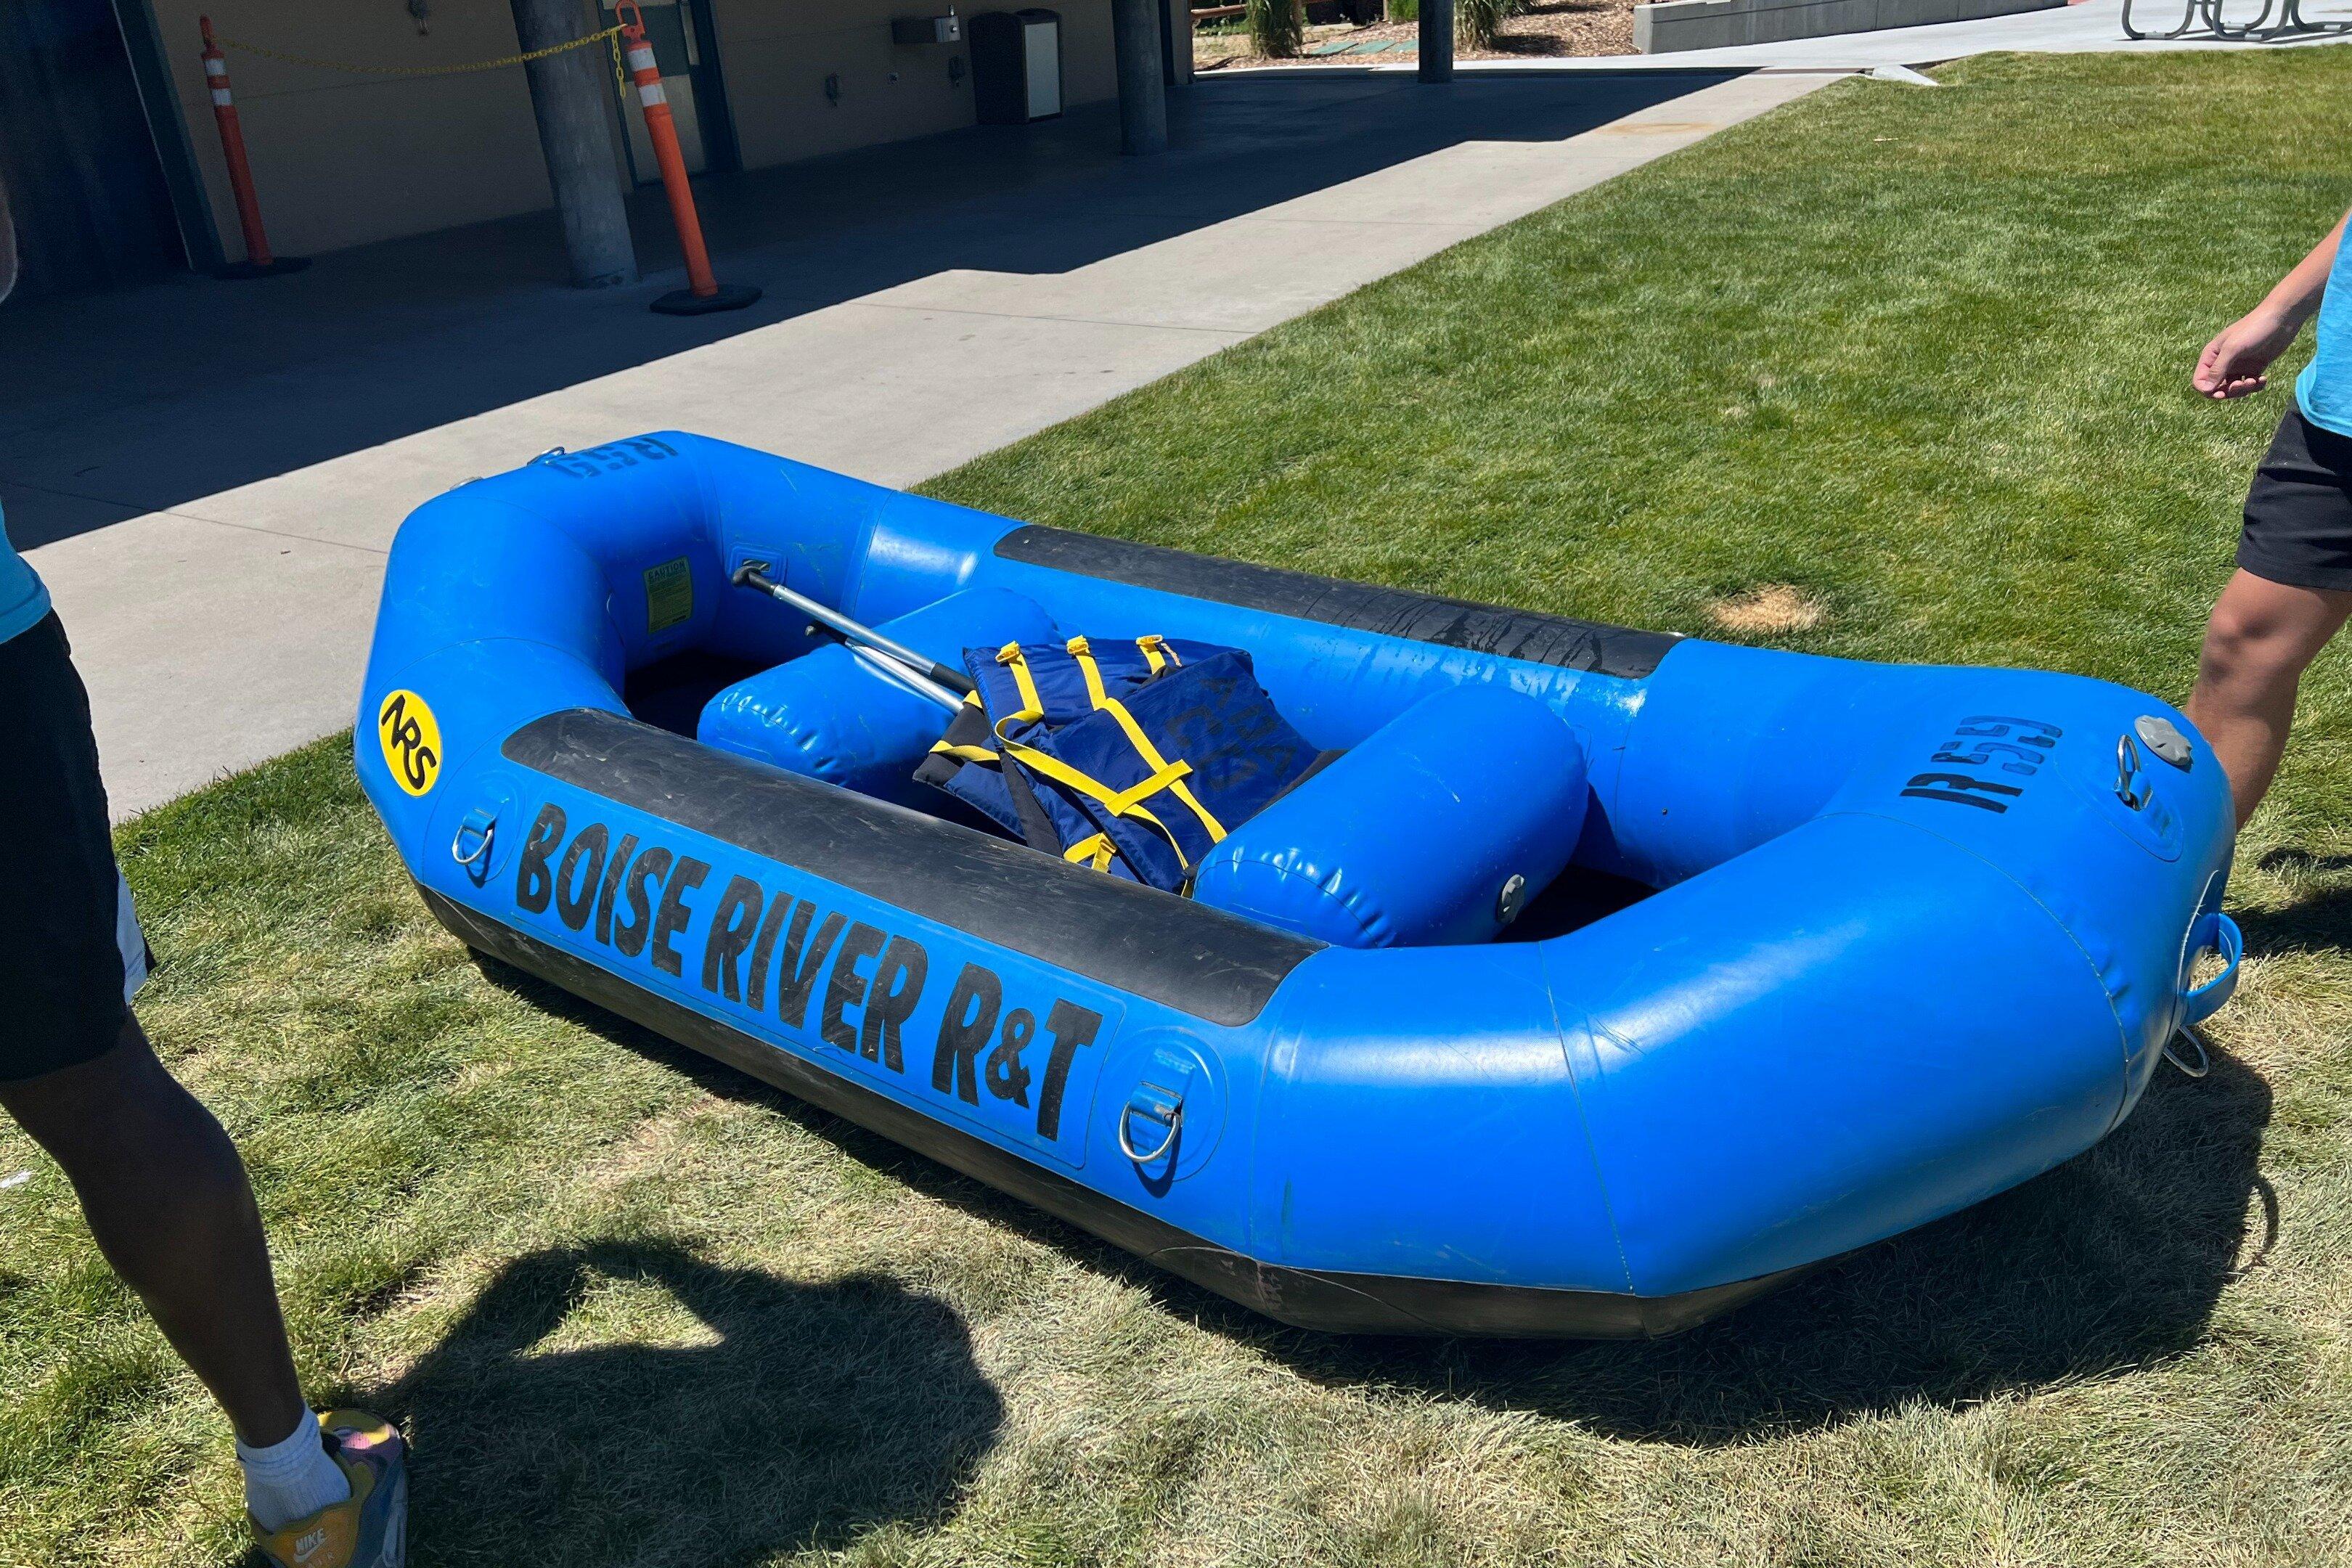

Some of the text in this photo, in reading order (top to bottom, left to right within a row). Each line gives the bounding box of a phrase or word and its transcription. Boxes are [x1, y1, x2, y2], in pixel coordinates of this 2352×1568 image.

[648, 560, 686, 579] CAUTION
[381, 694, 437, 791] NRS
[516, 801, 1104, 1143] BOISE RIVER R&T
[295, 1527, 325, 1551] NIKE
